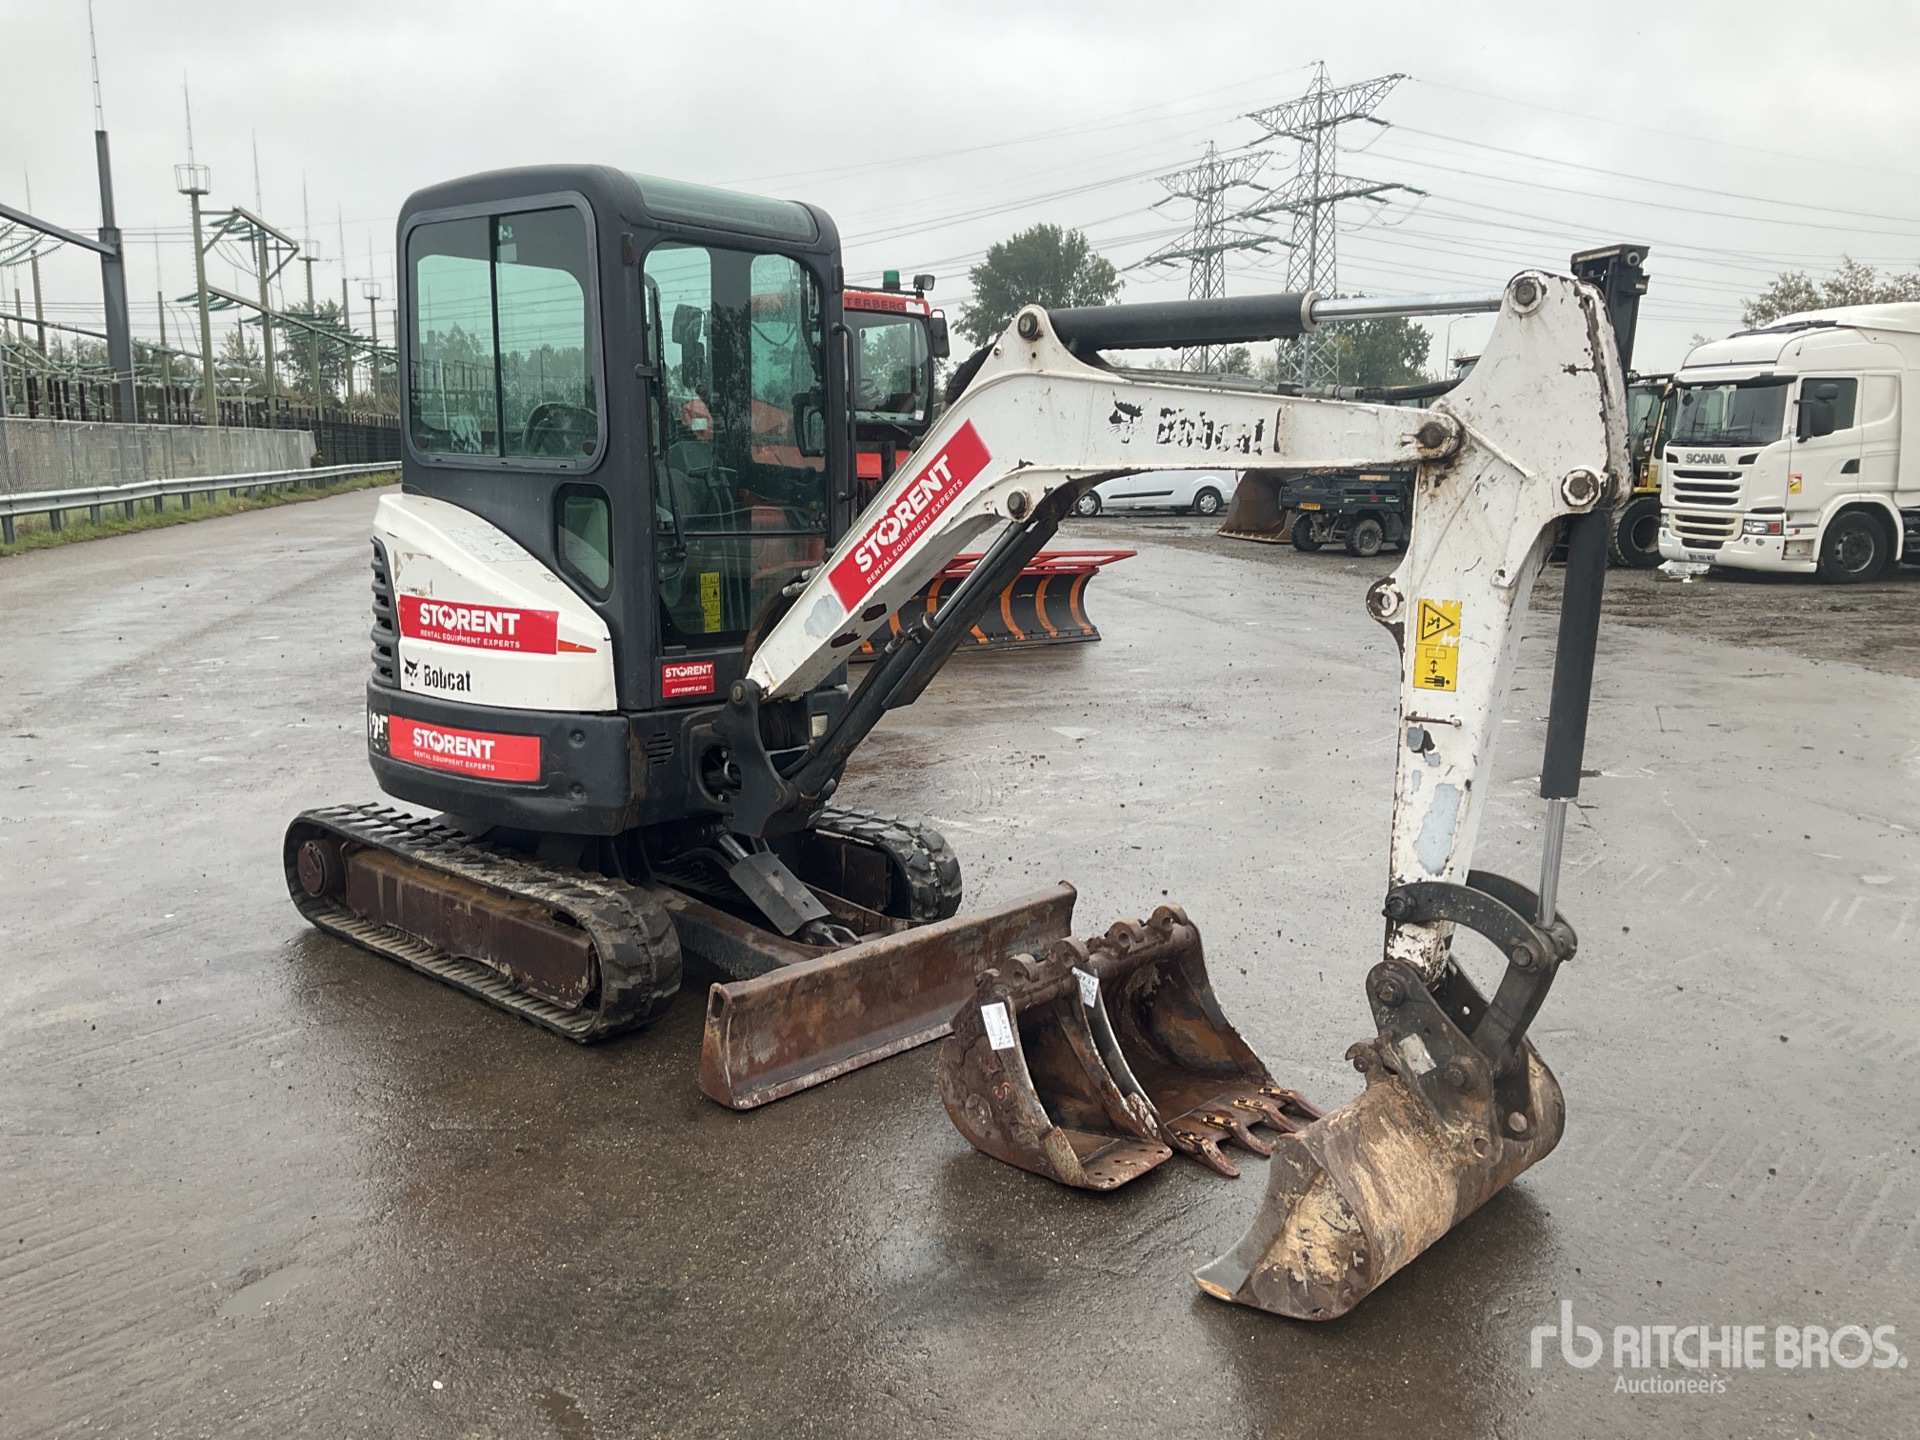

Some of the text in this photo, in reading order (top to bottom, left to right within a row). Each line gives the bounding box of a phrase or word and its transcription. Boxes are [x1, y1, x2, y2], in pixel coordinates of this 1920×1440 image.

[844, 297, 905, 311] TERBERG
[1685, 453, 1727, 464] SCANIA
[854, 453, 953, 573] STORENT
[866, 478, 963, 585] RENTAL EQUIPMENT EXPERTS
[419, 602, 520, 636] STORENT
[420, 629, 521, 649] RENTAL EQUIPMENT EXPERTS
[423, 663, 472, 692] Bobcat
[665, 664, 713, 678] STORENT
[413, 727, 495, 760] STORENT
[413, 749, 496, 771] RENTAL EQUIPMENT EXPERTS
